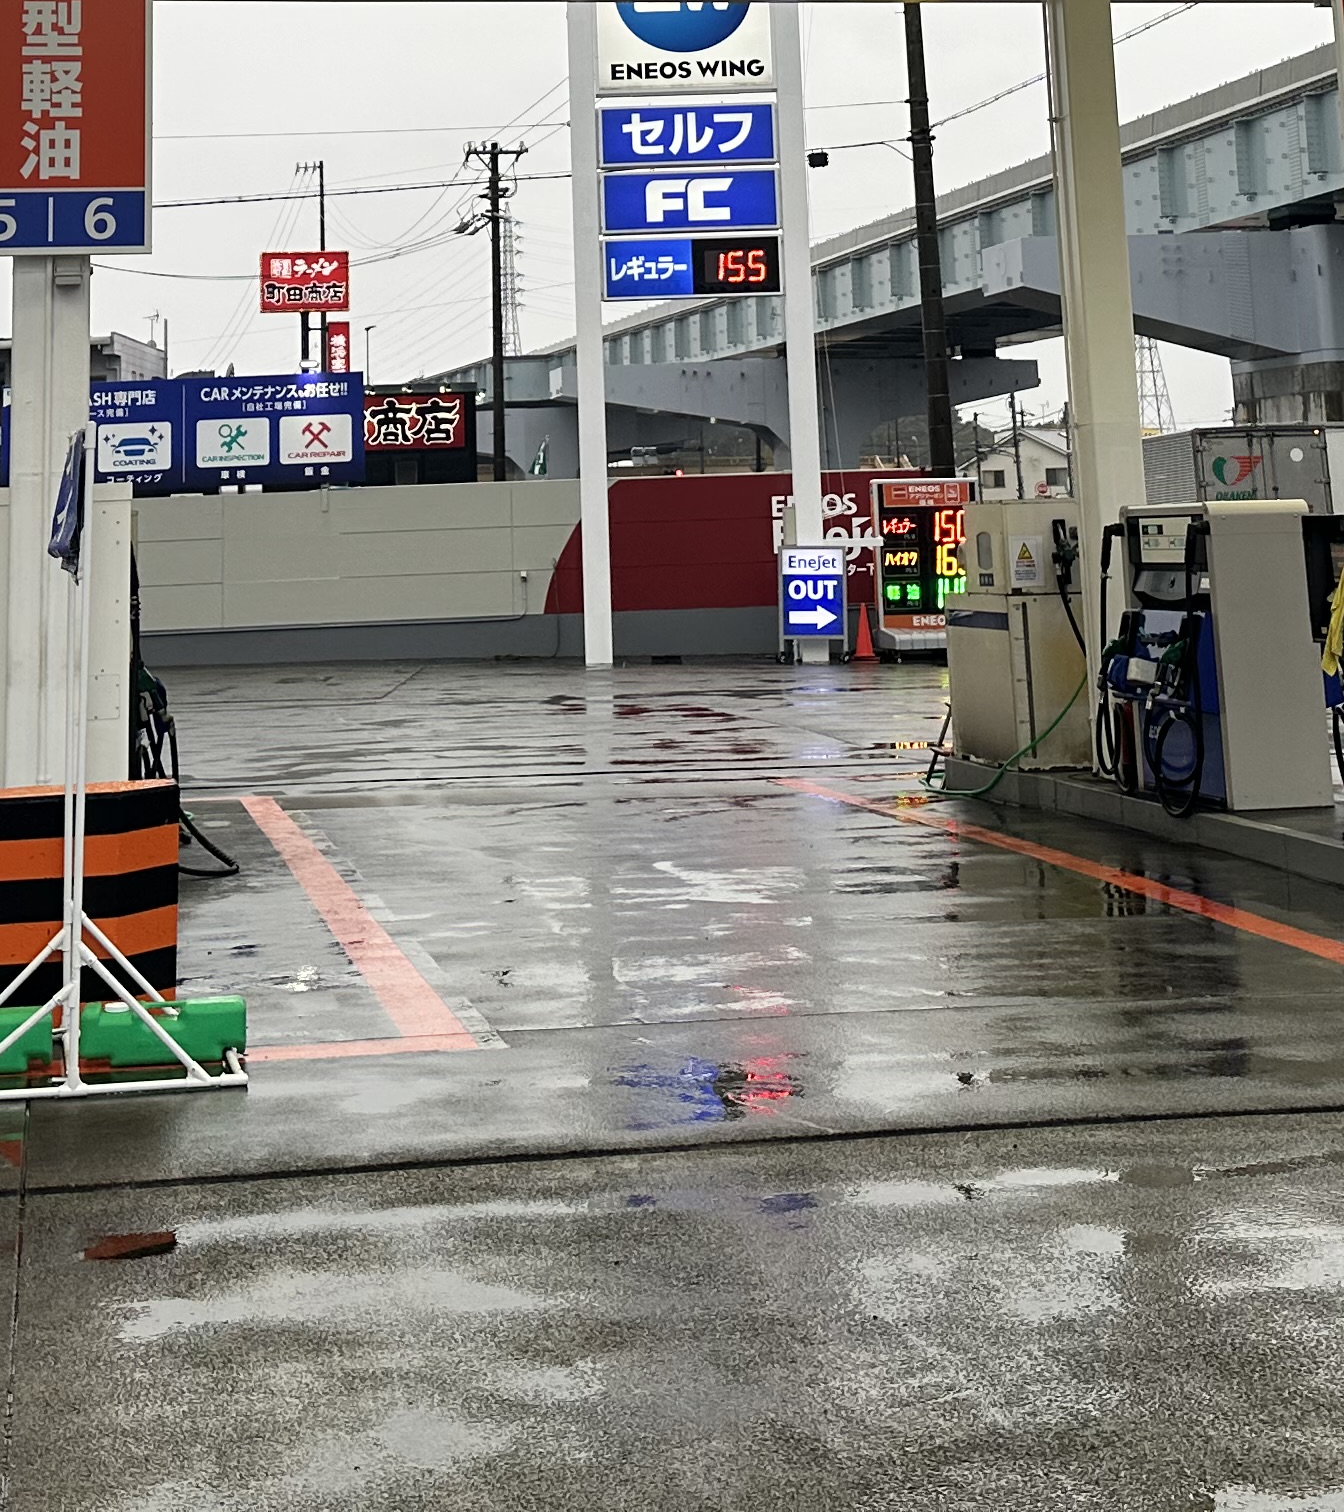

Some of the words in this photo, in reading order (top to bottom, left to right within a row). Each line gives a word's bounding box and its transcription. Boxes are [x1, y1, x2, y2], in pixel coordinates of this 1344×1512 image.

[610, 60, 692, 81] ENEOS
[697, 59, 765, 78] WING
[621, 111, 754, 156] セルフ
[645, 176, 734, 223] FC
[84, 196, 118, 241] 6
[292, 257, 339, 278] ラーメン
[610, 255, 688, 282] レギュラー
[716, 249, 768, 284] 155
[264, 281, 346, 305] 町田商店
[90, 391, 112, 406] SH
[200, 387, 229, 401] CAR
[363, 398, 460, 445] 商店
[112, 458, 157, 467] COATING
[287, 451, 309, 459] CAR
[309, 450, 346, 458] REPAIR
[771, 493, 858, 517] EOS
[882, 517, 917, 535] レギュラー
[884, 551, 918, 567] ハイオク
[936, 542, 967, 577] 16
[787, 579, 838, 601] OUT
[911, 614, 946, 626] ENEO
